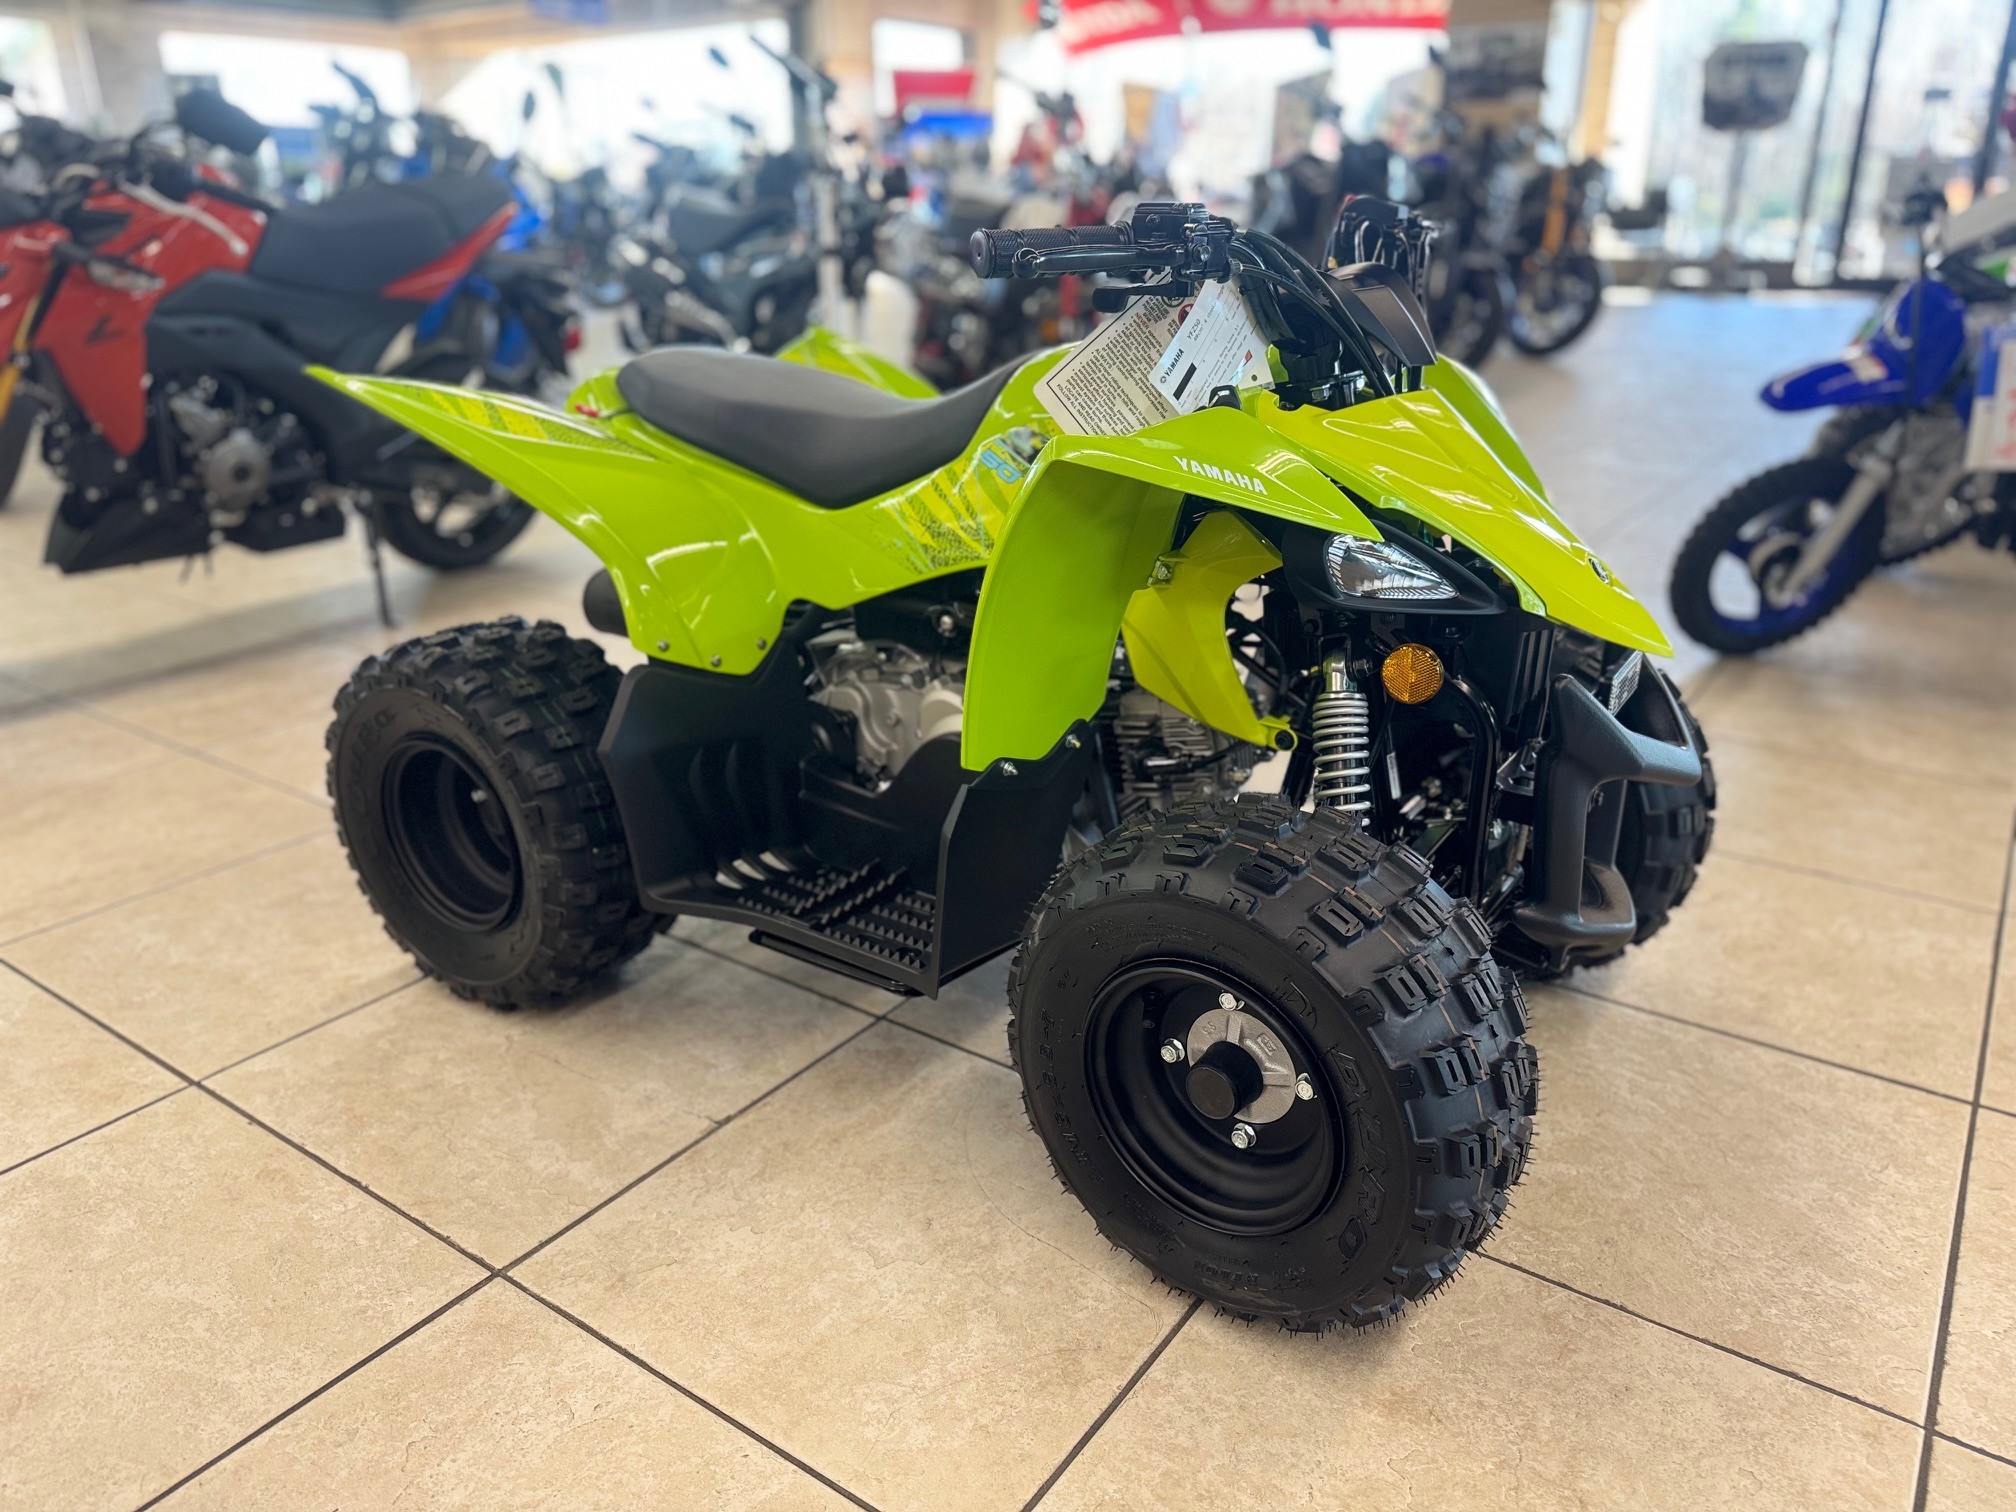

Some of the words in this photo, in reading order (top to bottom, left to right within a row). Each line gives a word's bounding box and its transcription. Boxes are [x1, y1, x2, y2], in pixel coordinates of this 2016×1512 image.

[1134, 312, 1149, 330] NEVER
[1094, 347, 1112, 369] ALWAYS
[1164, 348, 1185, 377] YAMAHA
[980, 449, 1022, 484] 50
[1173, 455, 1268, 496] YAMAHA
[1329, 1047, 1389, 1261] DURO
